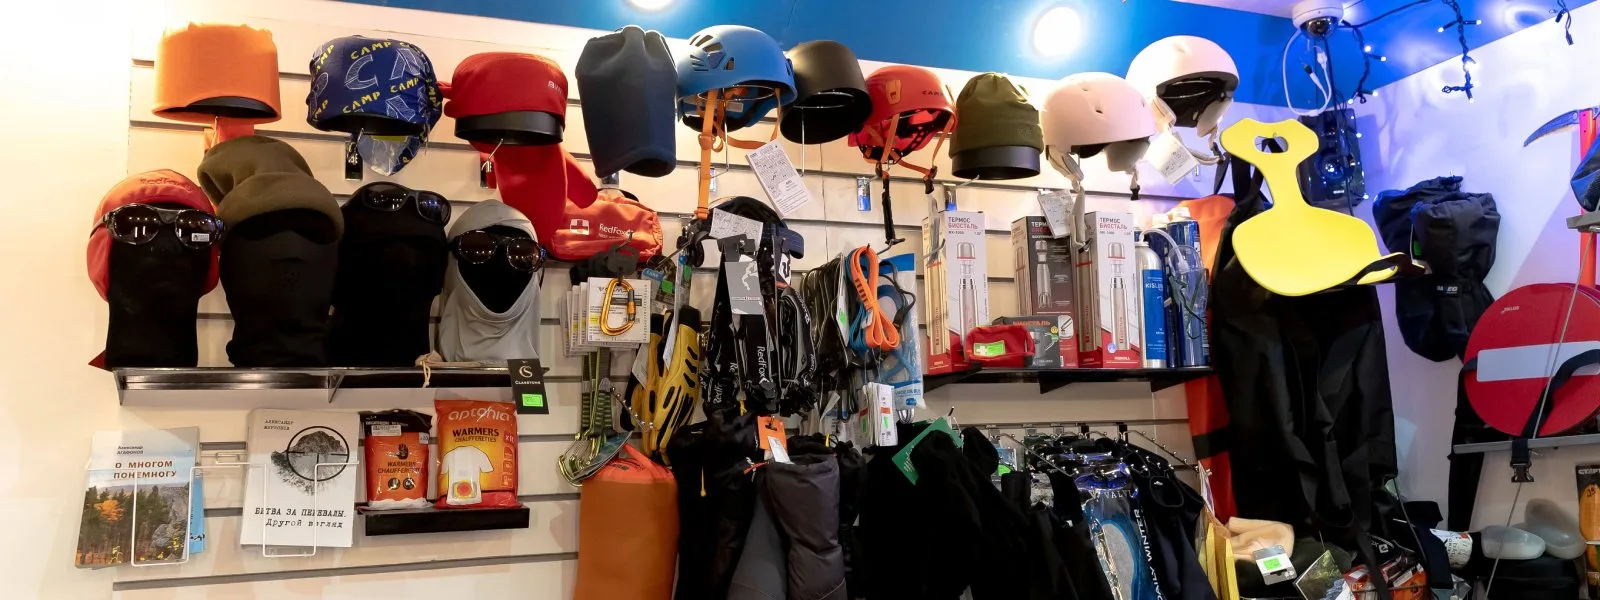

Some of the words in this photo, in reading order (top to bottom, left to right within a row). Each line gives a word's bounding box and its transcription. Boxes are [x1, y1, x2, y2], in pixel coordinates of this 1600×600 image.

[351, 41, 392, 60] CAMP
[391, 78, 420, 93] CAMP
[342, 91, 381, 113] CAMP
[599, 223, 626, 236] RedFox
[757, 346, 767, 378] RedFox
[453, 427, 499, 437] WARMERS
[455, 435, 496, 443] CHAUFFERETTES
[129, 460, 172, 468] МНОГОМ
[114, 470, 176, 479] ПОНЕМНОГУ
[266, 518, 302, 527] Другой
[1134, 509, 1152, 561] WINTER
